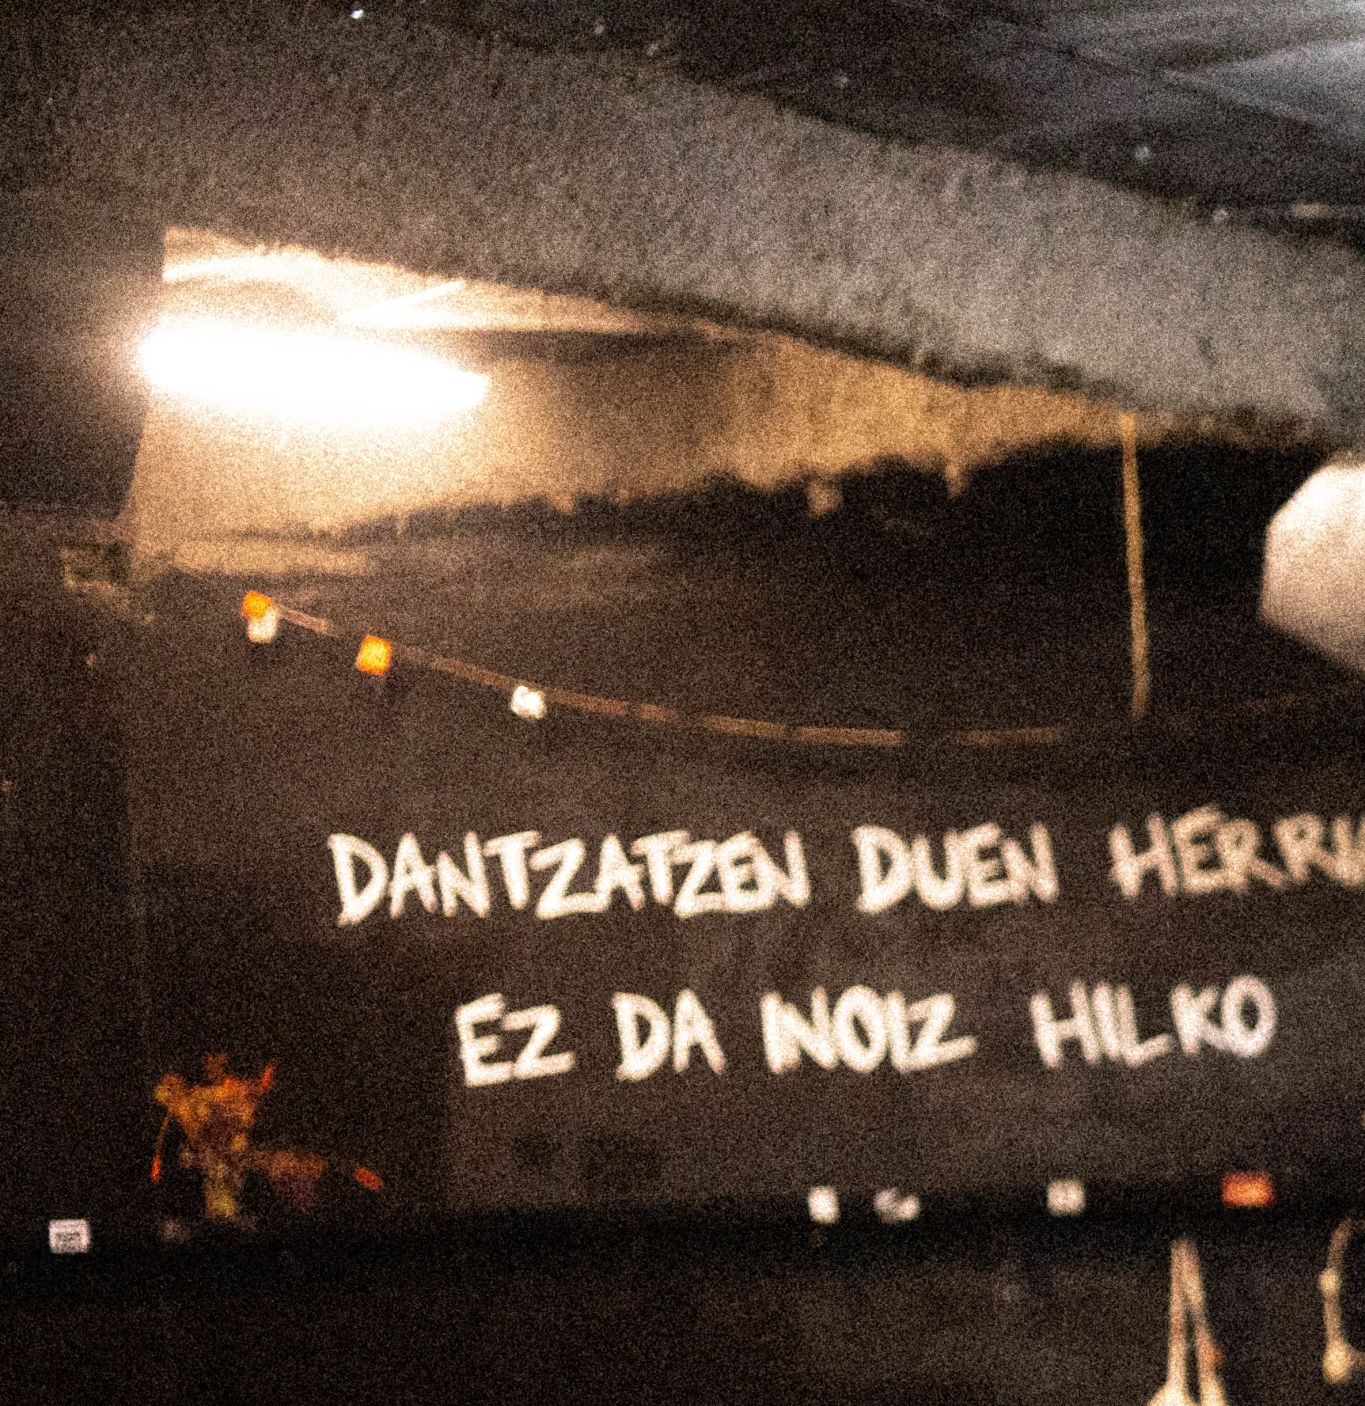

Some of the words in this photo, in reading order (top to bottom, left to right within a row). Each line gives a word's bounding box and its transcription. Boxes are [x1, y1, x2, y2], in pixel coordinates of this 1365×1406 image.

[329, 828, 811, 927] DANTZATZEN
[852, 820, 1060, 915] DUEN
[454, 992, 577, 1088] EZ
[613, 988, 726, 1081] DA
[762, 984, 977, 1075] NOIZ
[1030, 974, 1279, 1070] HILKO
